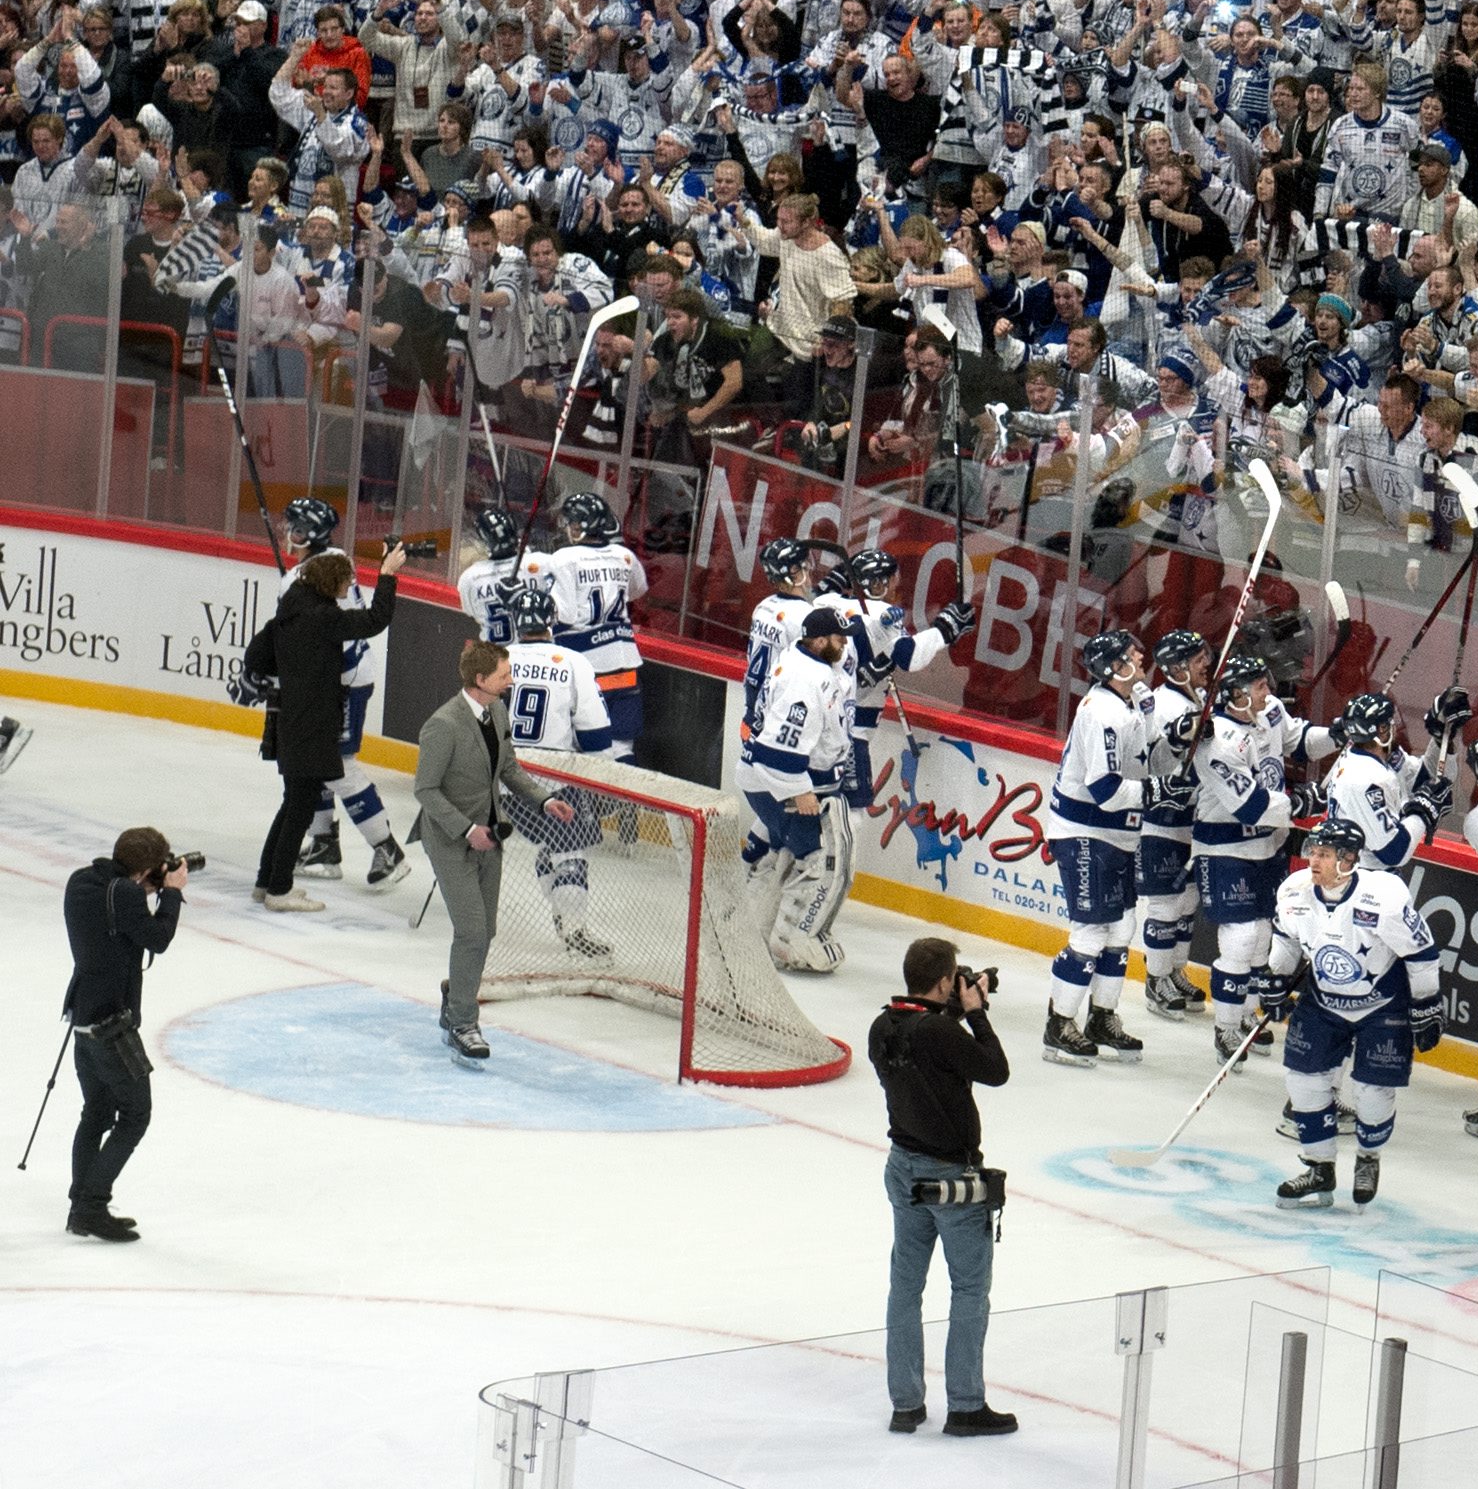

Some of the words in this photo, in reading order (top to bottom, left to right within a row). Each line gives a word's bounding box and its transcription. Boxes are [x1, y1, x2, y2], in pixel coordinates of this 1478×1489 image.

[202, 578, 262, 650] Vill
[587, 585, 629, 627] 14
[0, 604, 118, 663] ngbers
[160, 636, 249, 683] Lång
[509, 663, 569, 684] RSBERG
[776, 724, 802, 748] 35
[975, 862, 1067, 901] DALAR
[992, 888, 1012, 905] TEL
[1014, 893, 1052, 914] 020-21
[799, 885, 830, 933] Reebok
